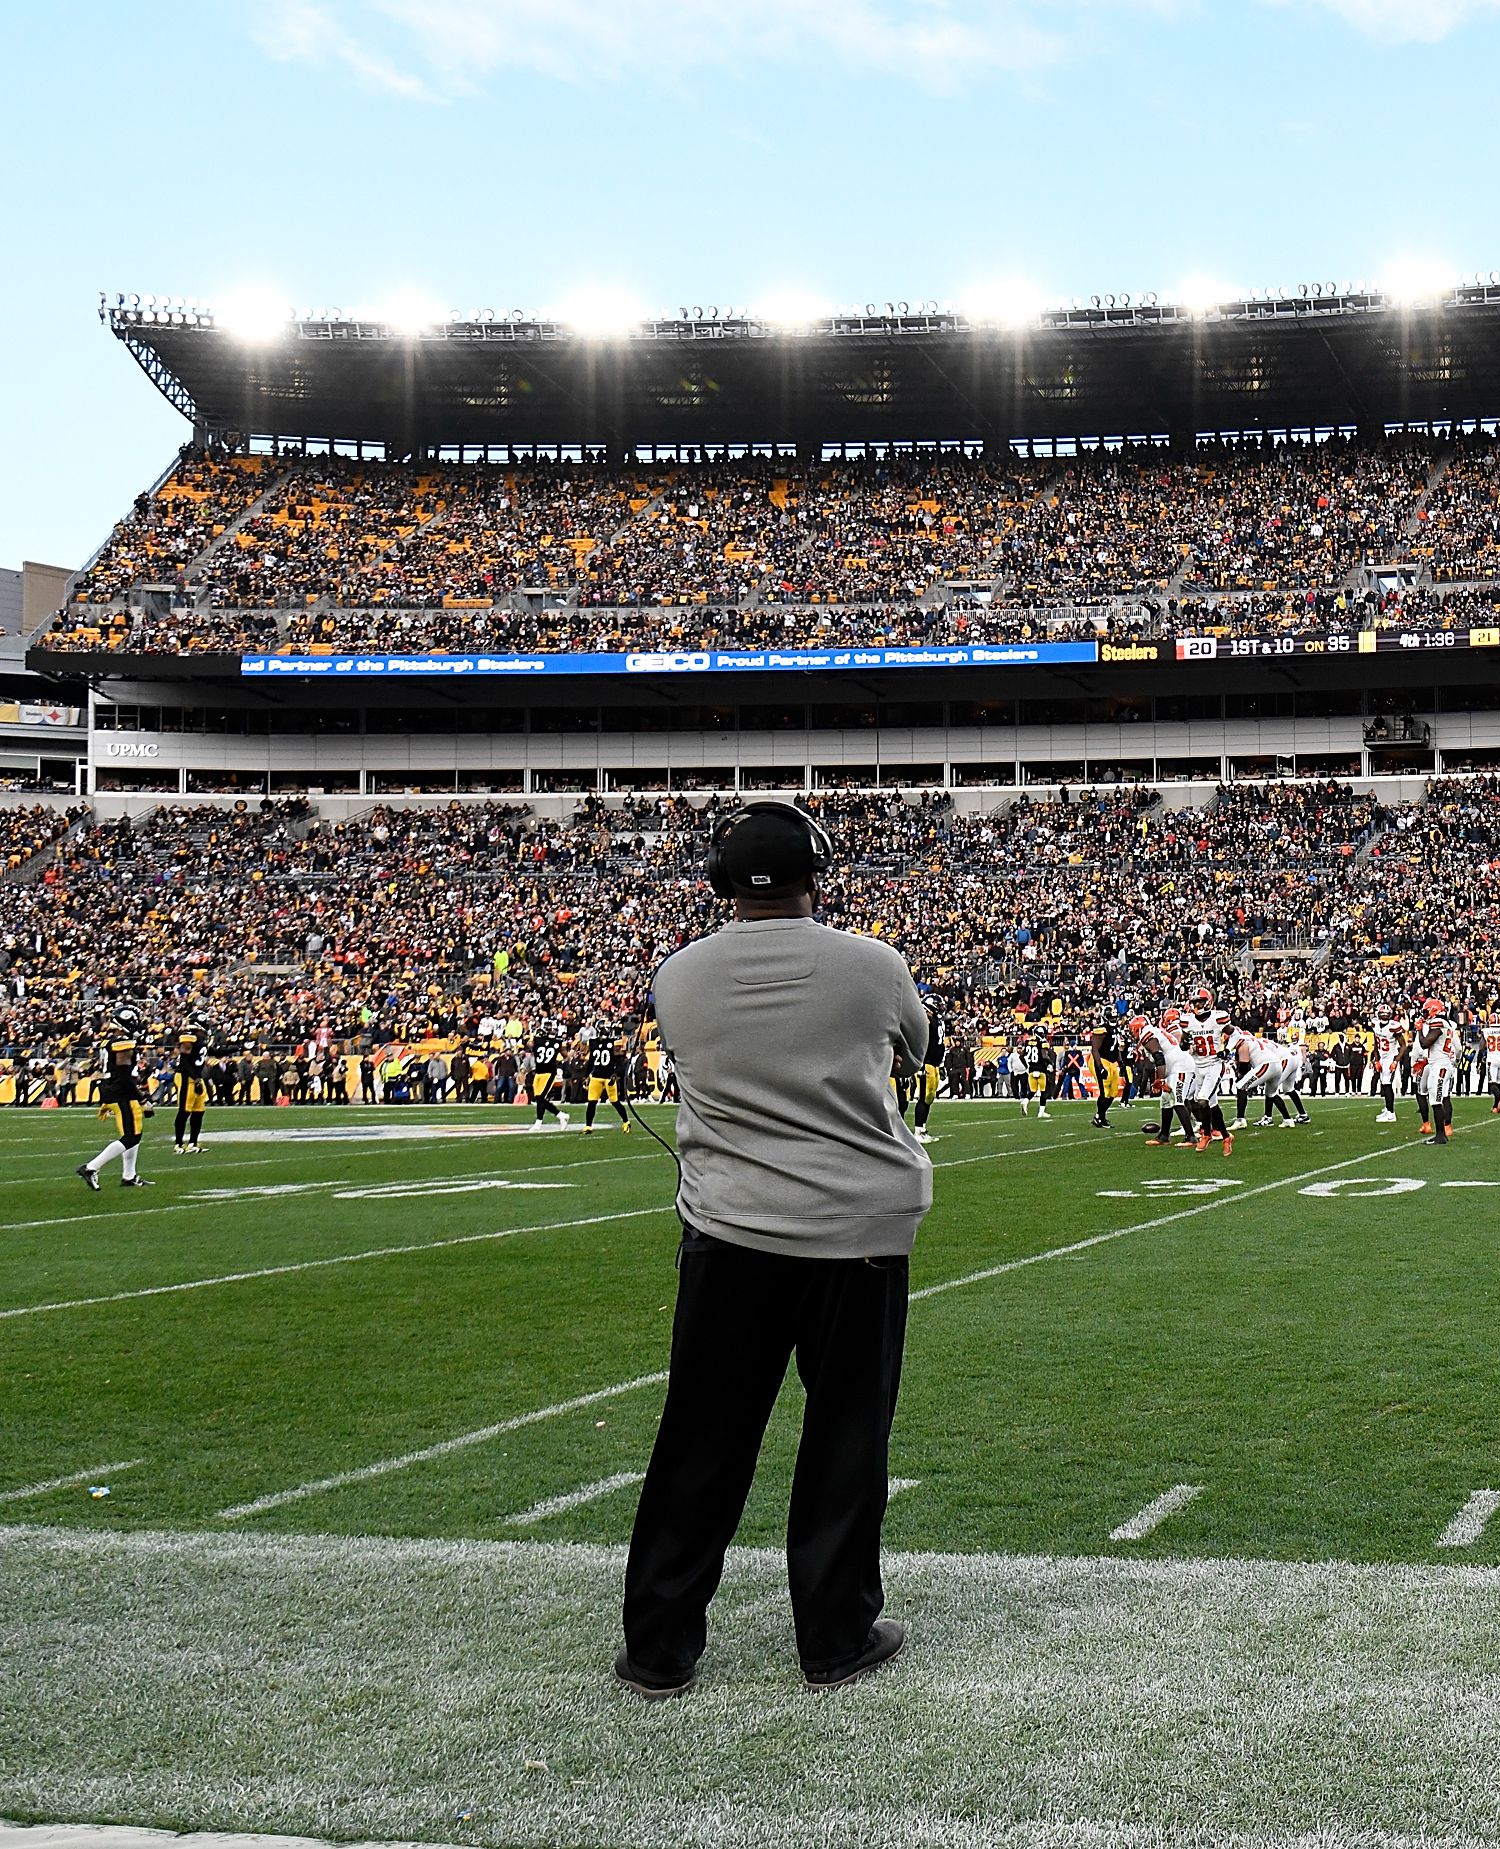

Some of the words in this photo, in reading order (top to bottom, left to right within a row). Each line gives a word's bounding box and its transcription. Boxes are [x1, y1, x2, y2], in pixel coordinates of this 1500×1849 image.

[1101, 643, 1158, 661] Steelers
[1189, 643, 1212, 655] 20
[1273, 638, 1295, 654] 10
[1304, 641, 1324, 652] ON
[1327, 636, 1350, 651] 35
[1399, 633, 1420, 648] 4th
[1423, 632, 1455, 647] 1:36
[1478, 631, 1491, 643] 21
[269, 660, 332, 671] Partner
[336, 660, 354, 671] of
[357, 660, 384, 671] the
[387, 659, 473, 672] Pittsburgh
[478, 659, 545, 671] Steelers
[626, 653, 711, 671] GEICO
[717, 655, 764, 667] Proud
[769, 655, 830, 666] Partner
[834, 654, 850, 665] of
[854, 653, 880, 664] the
[884, 651, 968, 663] Pittsburgh
[972, 649, 1038, 661] Steelers
[107, 743, 159, 758] UPMC
[1026, 1046, 1039, 1063] 28
[1193, 1036, 1217, 1056] 81
[536, 1047, 555, 1064] 39
[593, 1050, 611, 1066] 20
